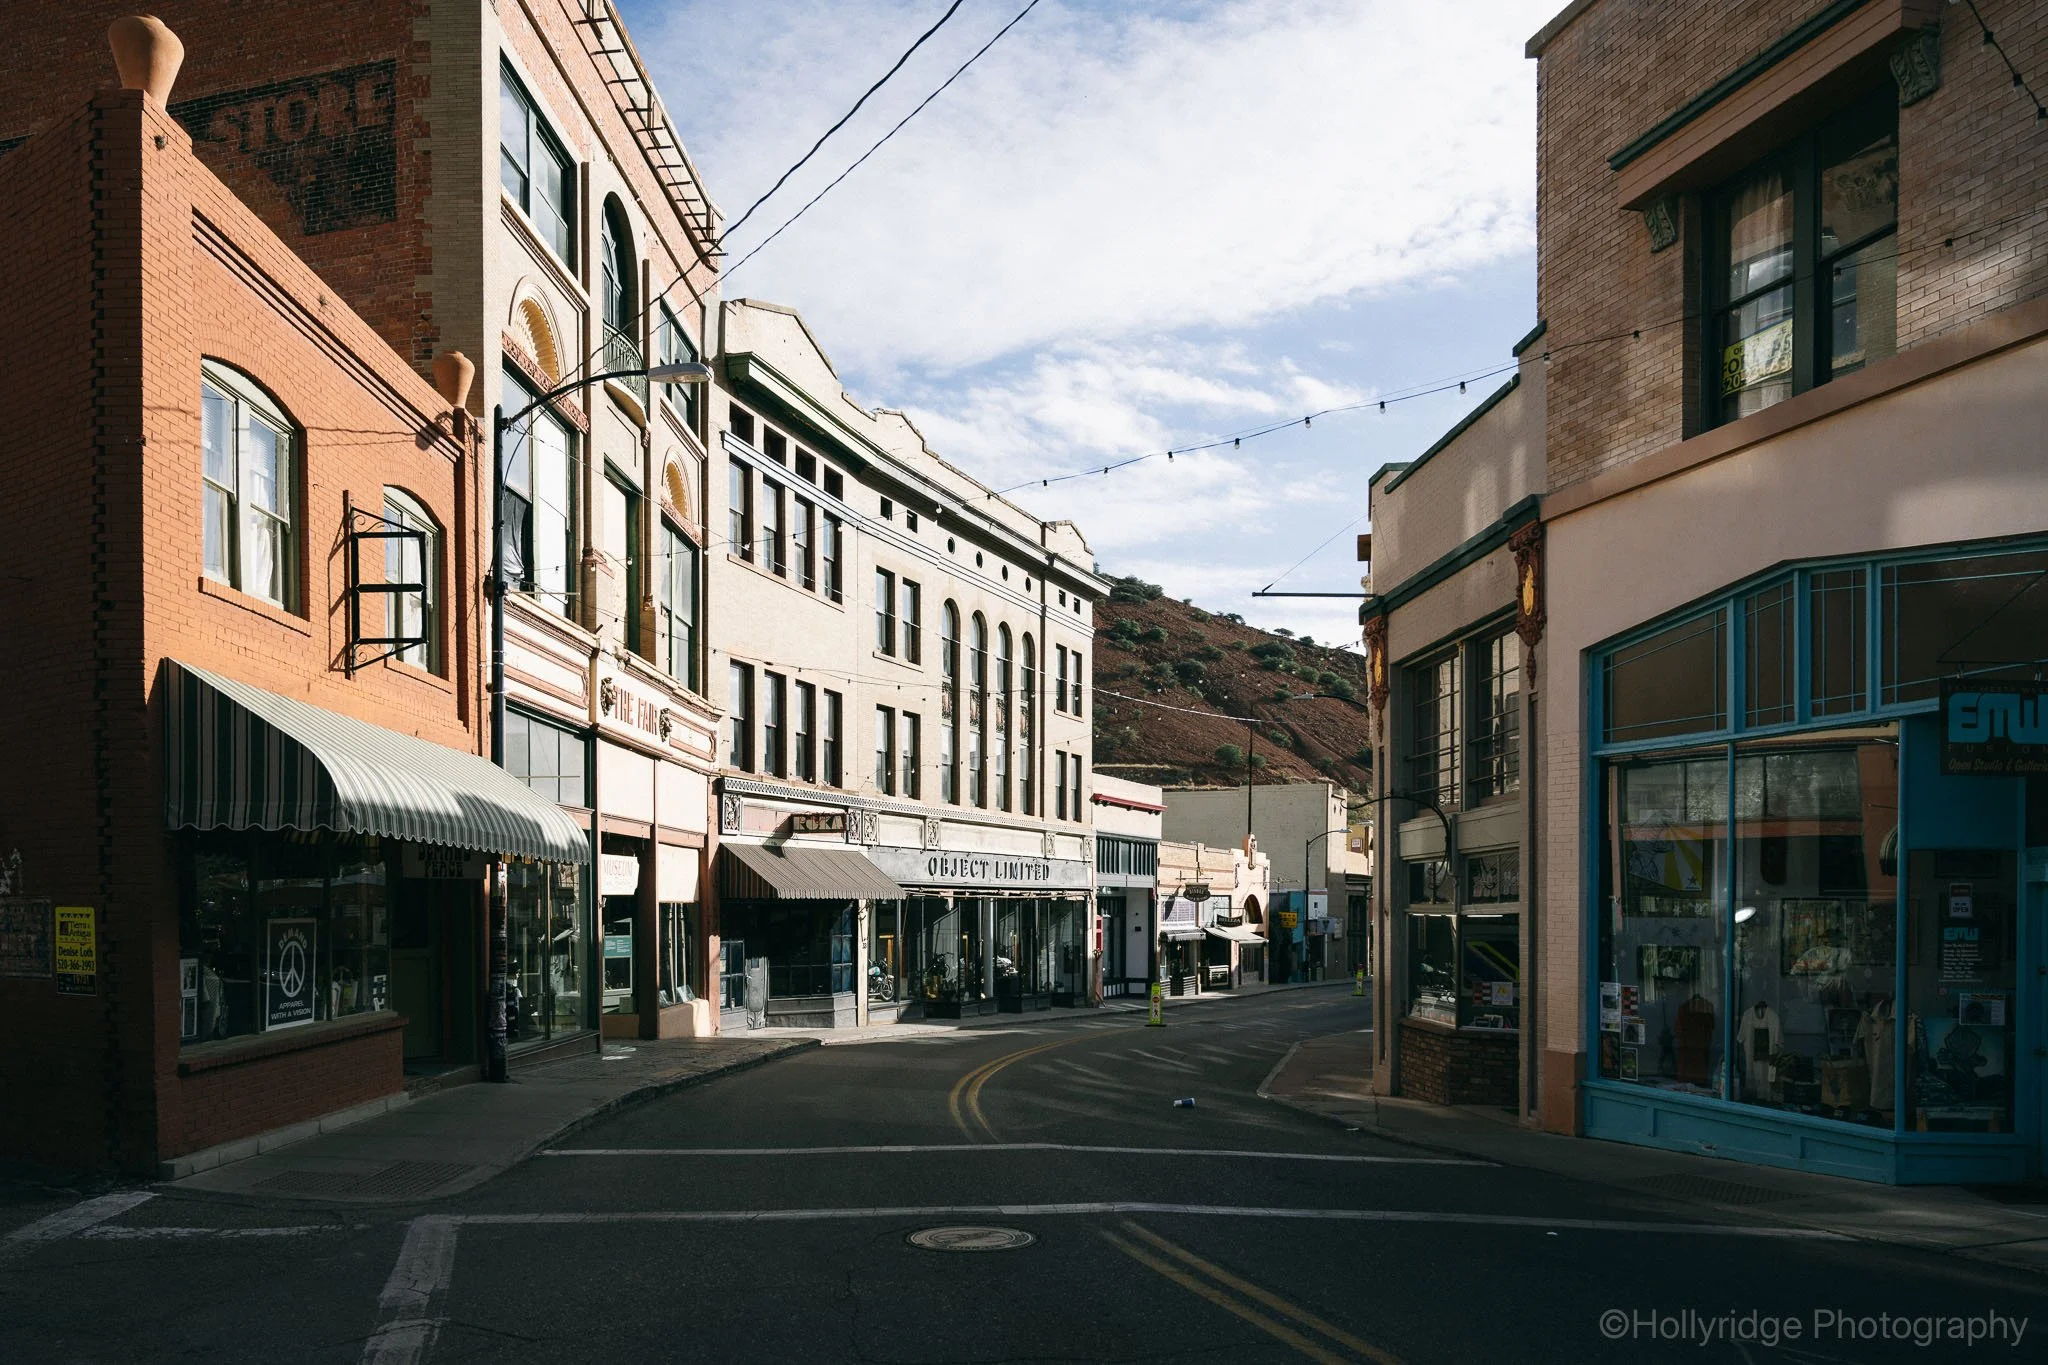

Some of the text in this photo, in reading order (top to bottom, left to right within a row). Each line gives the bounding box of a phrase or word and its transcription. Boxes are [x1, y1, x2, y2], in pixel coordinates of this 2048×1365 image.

[206, 75, 393, 151] STORE
[613, 685, 657, 736] THE FAIR
[1948, 757, 1972, 773] Open
[1973, 758, 2004, 772] Studio
[793, 815, 844, 830] ROKA
[928, 856, 1050, 881] OBJECT LIMITED
[278, 927, 308, 950] DEMAND
[270, 1011, 287, 1021] WITH
[293, 1007, 312, 1017] VISION
[278, 1000, 305, 1011] APPAREL
